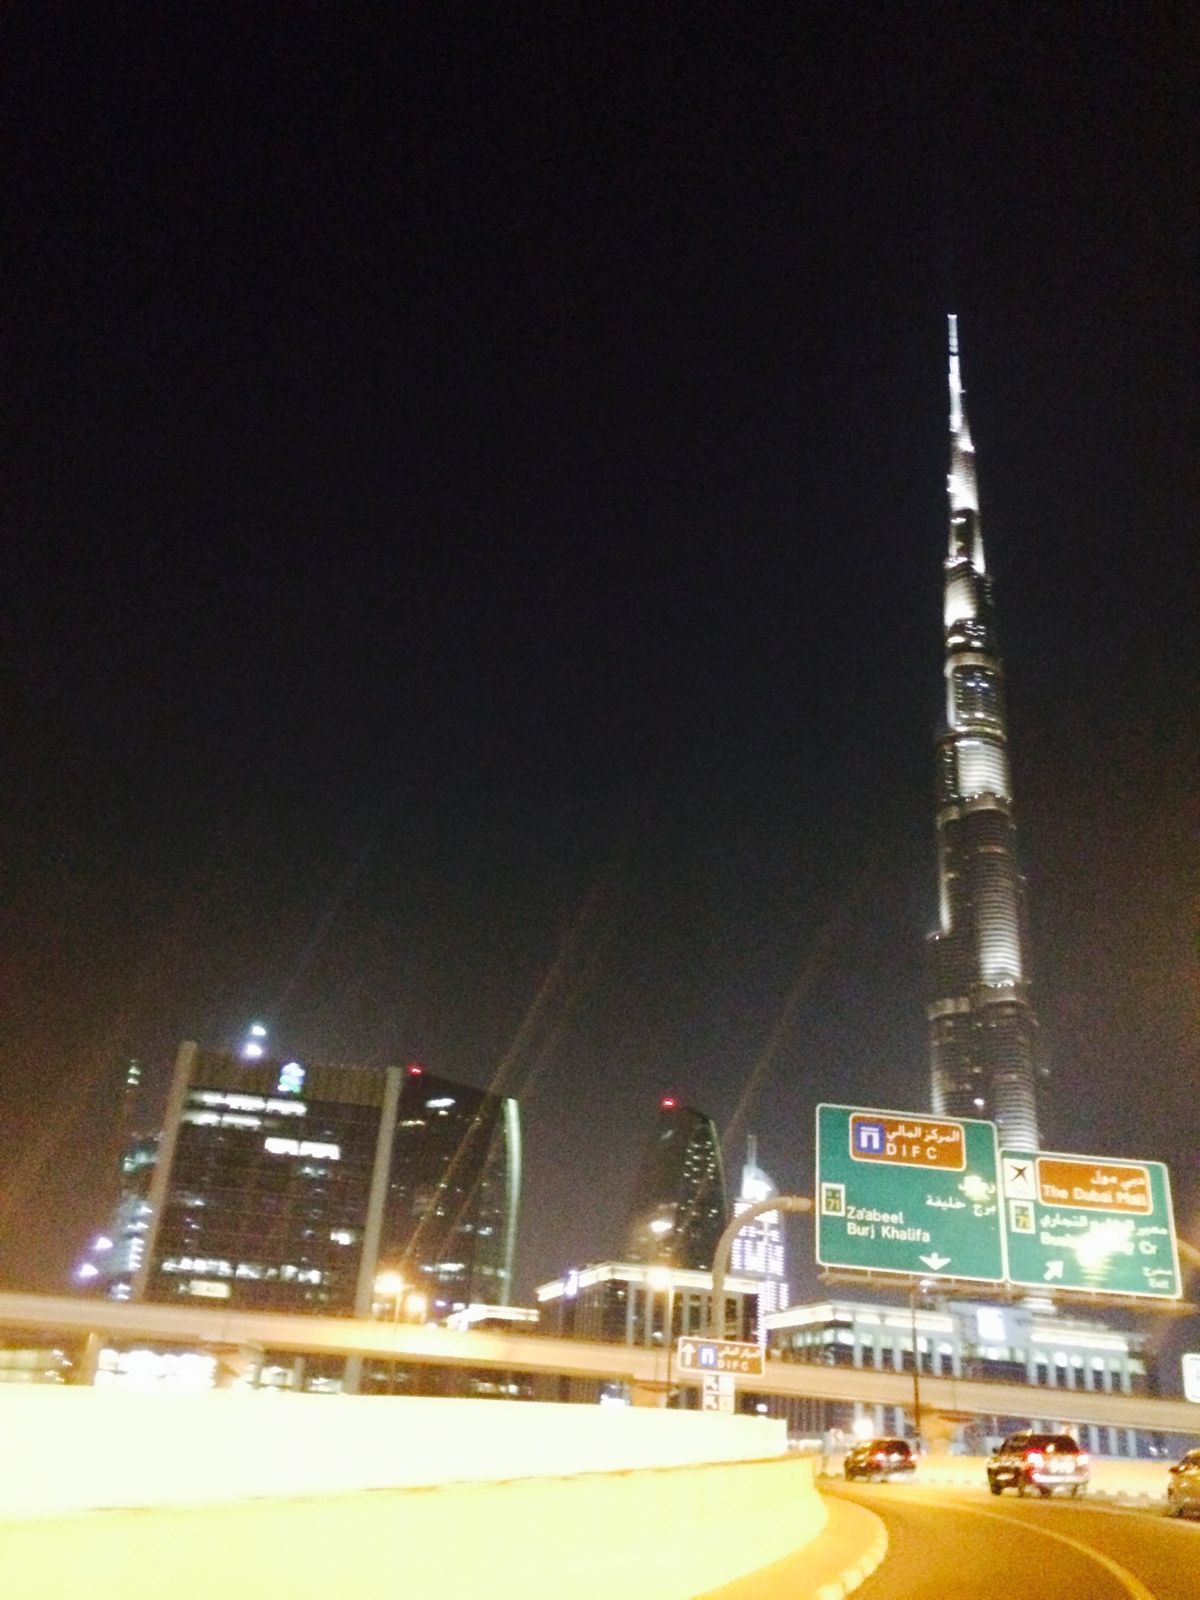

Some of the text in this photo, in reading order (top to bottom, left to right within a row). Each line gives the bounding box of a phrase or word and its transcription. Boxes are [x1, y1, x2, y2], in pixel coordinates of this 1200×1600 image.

[886, 1124, 960, 1144] المركز المالي
[1042, 1184, 1069, 1199] The
[1073, 1187, 1113, 1203] Dubai
[847, 1221, 931, 1242] Burj Khalifa
